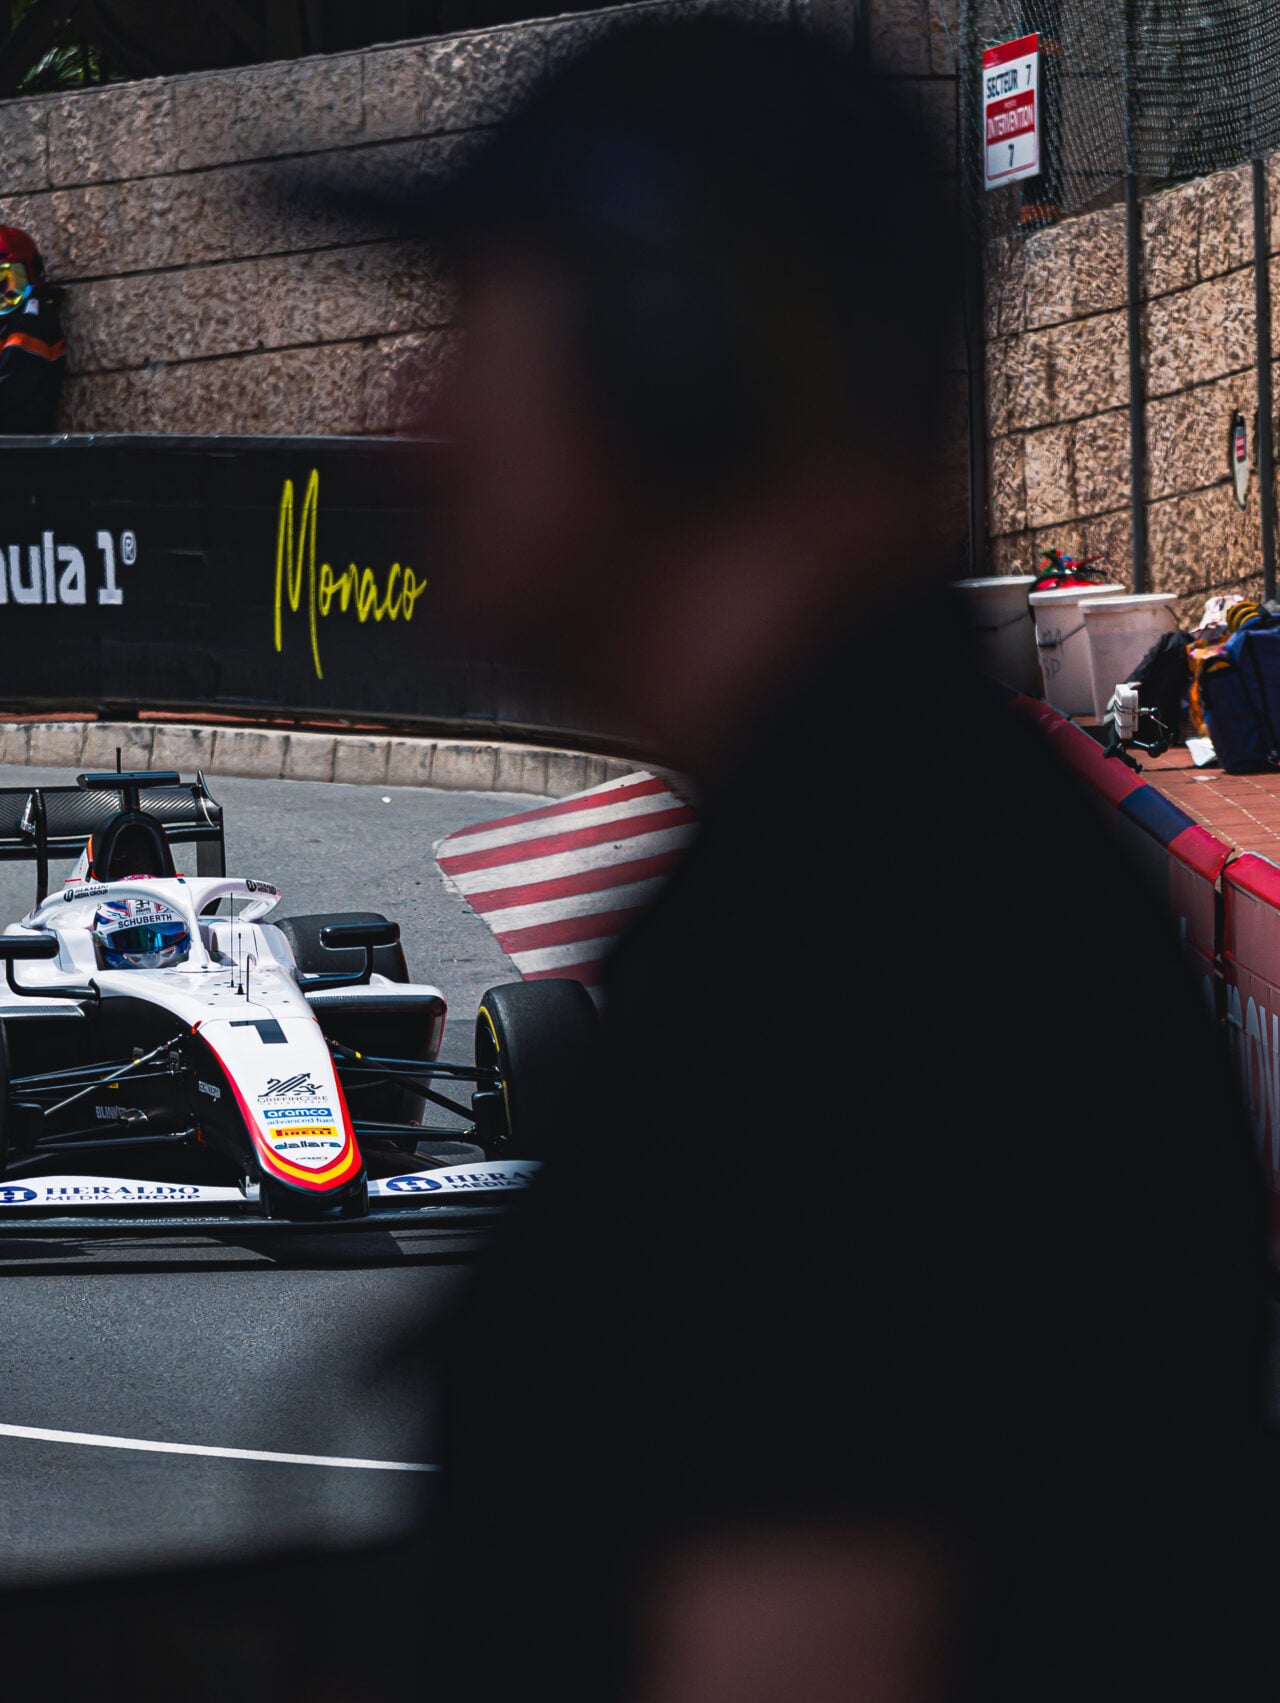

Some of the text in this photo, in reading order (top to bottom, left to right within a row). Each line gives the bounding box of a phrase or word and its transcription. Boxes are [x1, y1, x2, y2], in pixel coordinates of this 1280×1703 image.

[986, 64, 1032, 98] SECTEUR 7
[274, 467, 428, 680] Monaco
[118, 914, 173, 929] SCHUBERTH
[267, 1109, 329, 1118] aramco
[266, 1118, 315, 1126] advanced
[275, 1127, 332, 1137] PIRELLI
[274, 1141, 342, 1150] dallara
[451, 1181, 514, 1189] MEDIA
[45, 1186, 200, 1195] HERALDO
